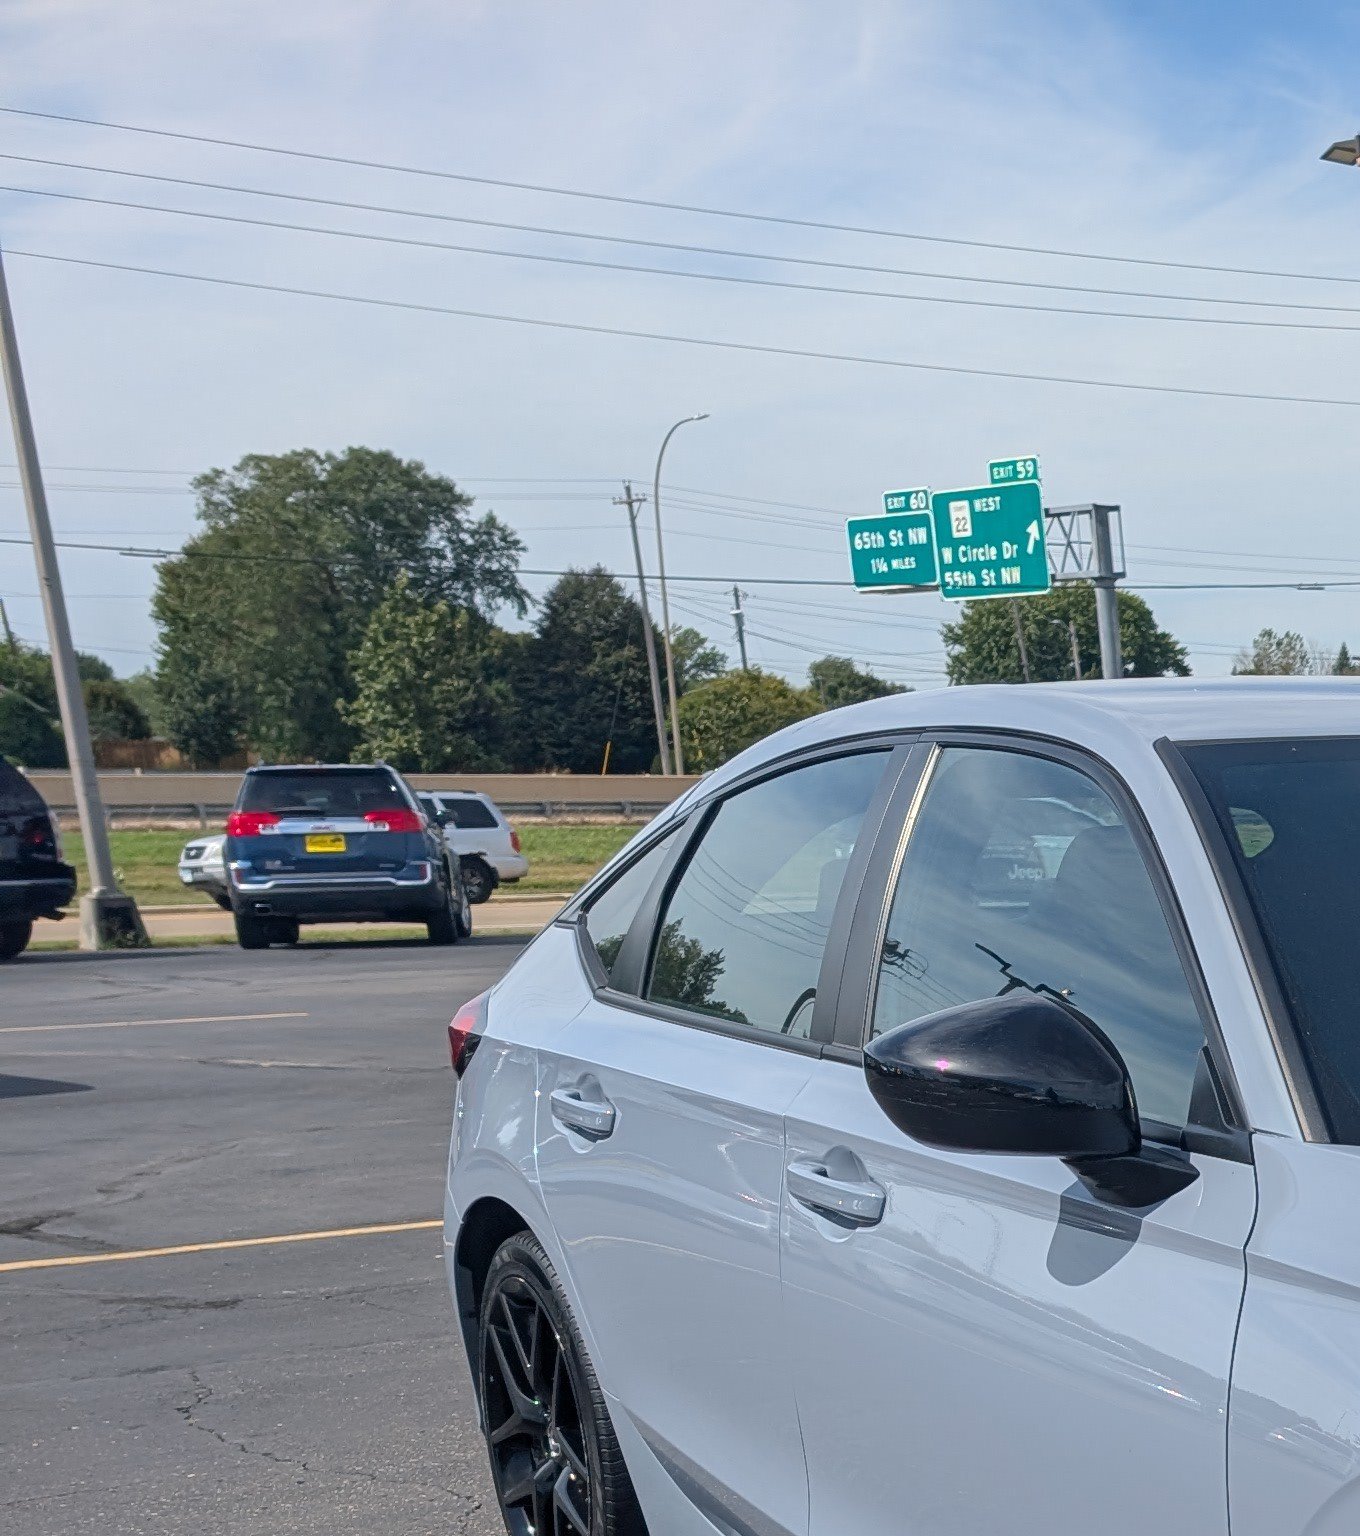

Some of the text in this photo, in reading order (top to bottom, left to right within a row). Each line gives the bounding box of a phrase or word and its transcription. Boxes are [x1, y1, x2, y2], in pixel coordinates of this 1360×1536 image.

[992, 461, 1034, 480] EXIT 59
[887, 492, 926, 510] EXIT 60
[973, 496, 1001, 512] WEST
[955, 517, 968, 533] 22
[854, 526, 927, 550] 65th St NW
[941, 541, 1018, 565] W Circle Dr
[891, 556, 916, 570] MILES
[944, 565, 1021, 589] 55th St NW
